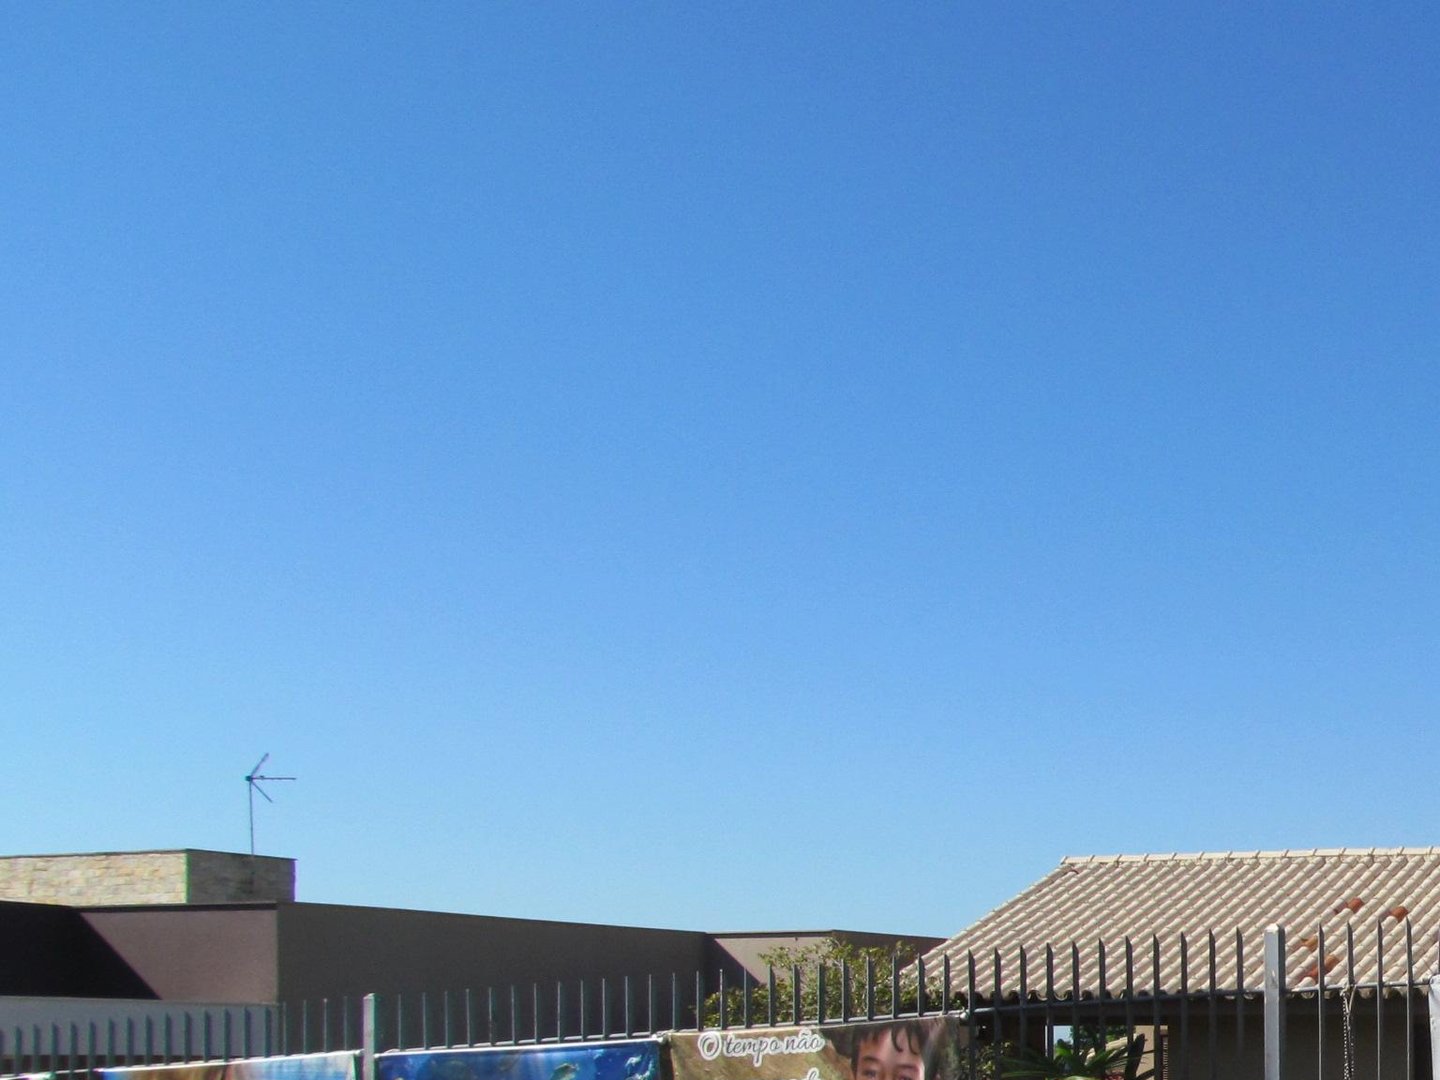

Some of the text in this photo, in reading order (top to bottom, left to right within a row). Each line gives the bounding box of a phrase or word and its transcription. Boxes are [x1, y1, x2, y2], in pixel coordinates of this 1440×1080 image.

[700, 1031, 823, 1064] O tempo não
